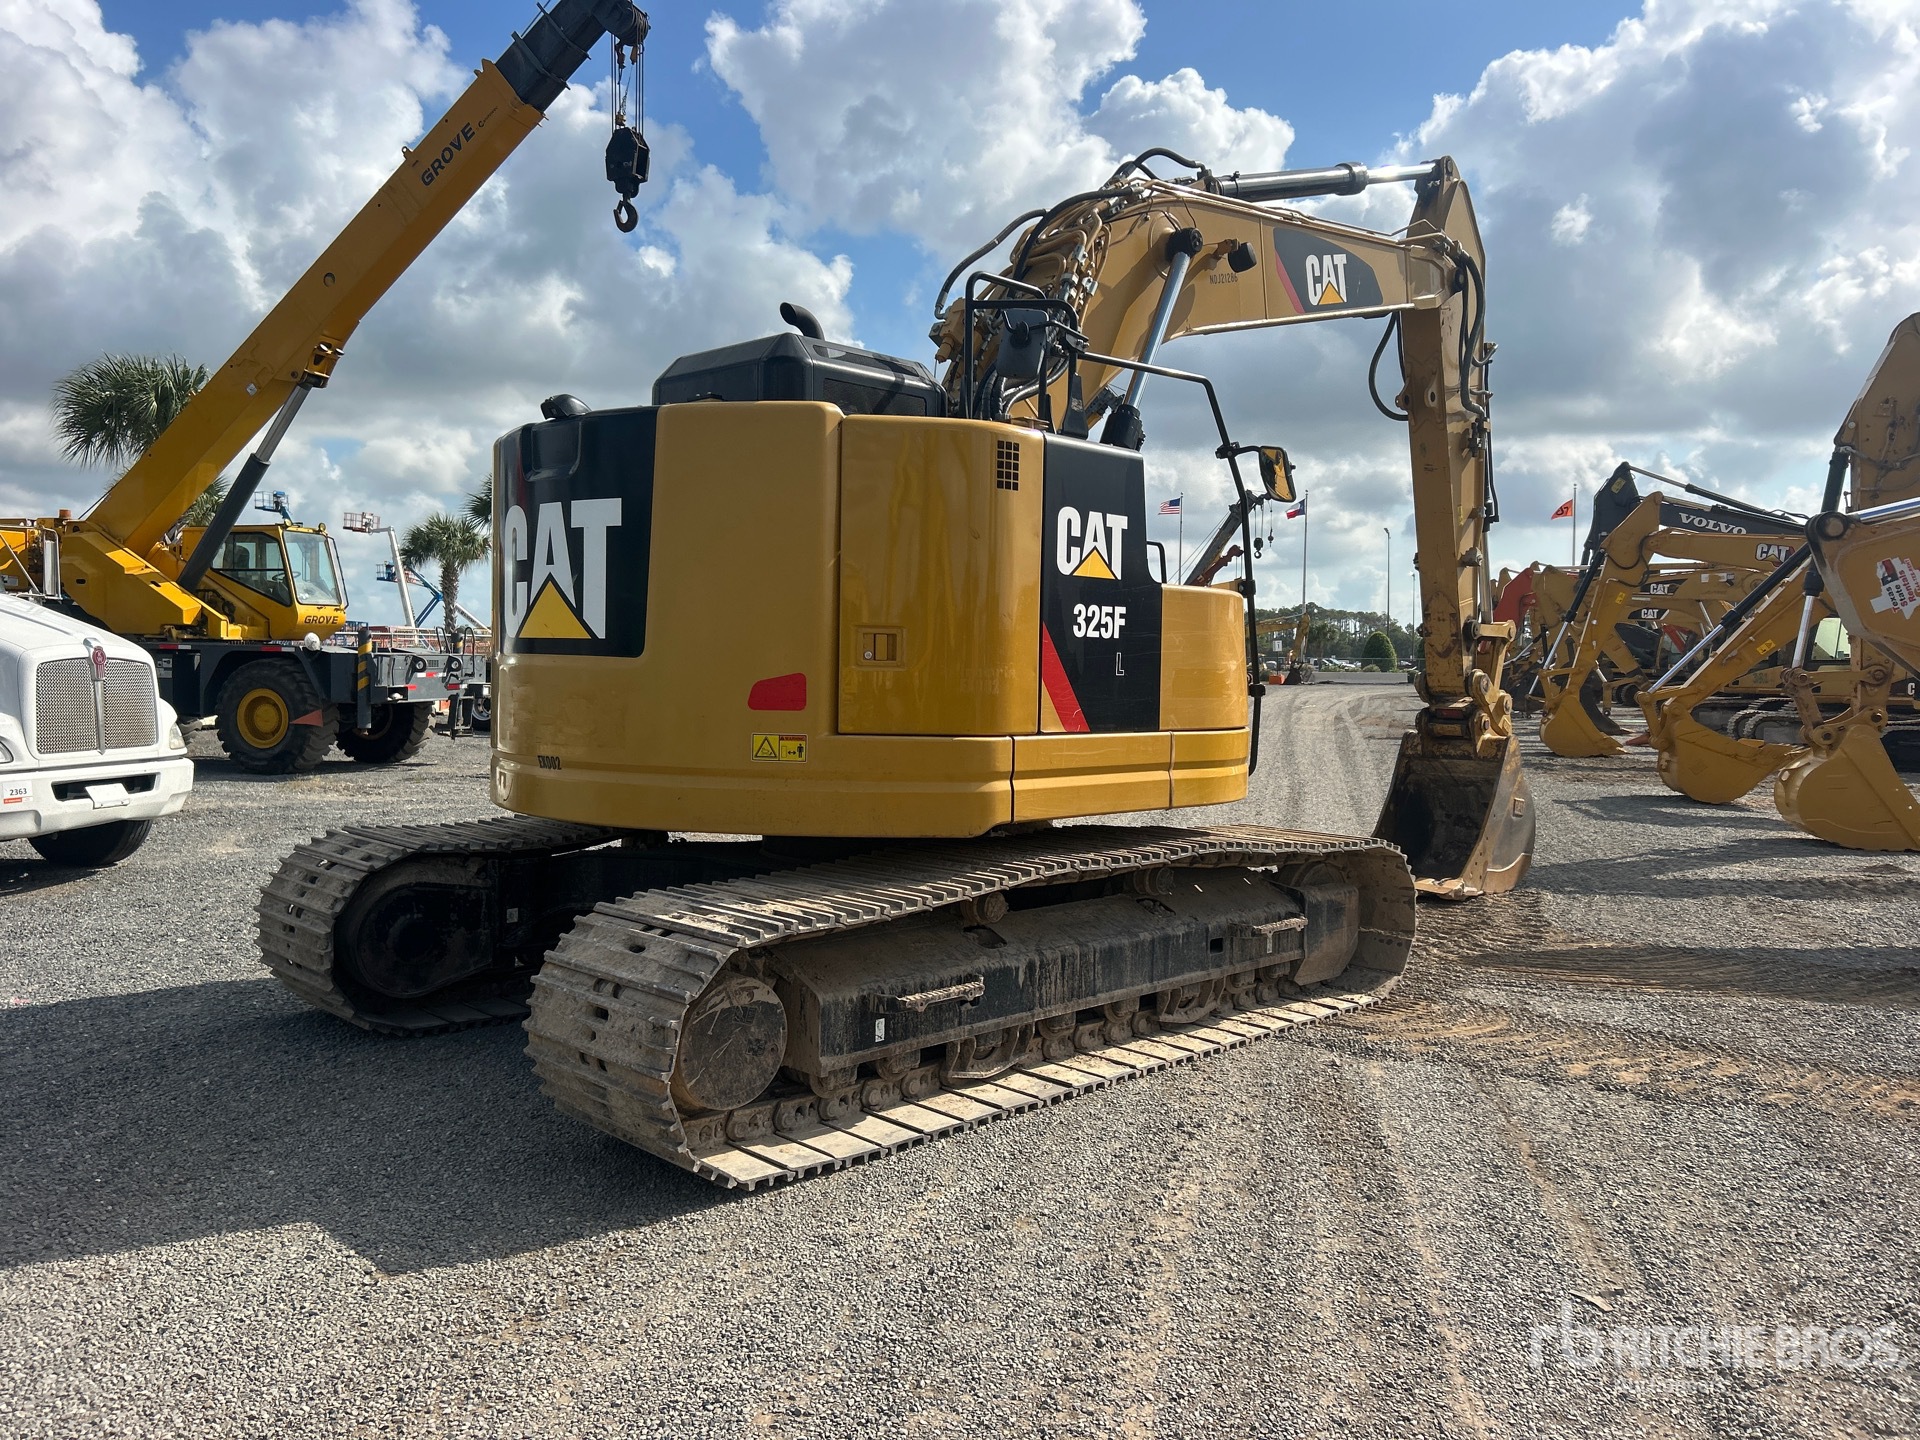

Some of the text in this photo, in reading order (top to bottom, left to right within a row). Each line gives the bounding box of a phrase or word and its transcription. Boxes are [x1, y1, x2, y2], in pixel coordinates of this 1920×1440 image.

[420, 121, 476, 187] GROVE
[1305, 253, 1348, 306] CAT
[1678, 512, 1747, 535] VOLVO
[1056, 505, 1129, 581] CAT
[1756, 543, 1790, 563] CAT
[504, 497, 622, 639] CAT
[1650, 583, 1670, 595] CAT
[1894, 584, 1909, 607] State
[1898, 569, 1917, 603] Rentals
[1885, 586, 1901, 613] Texas
[303, 614, 339, 625] GROVE
[1072, 603, 1127, 639] 325F
[1641, 608, 1659, 619] CAT
[1115, 651, 1125, 676] L
[9, 787, 28, 796] 2363
